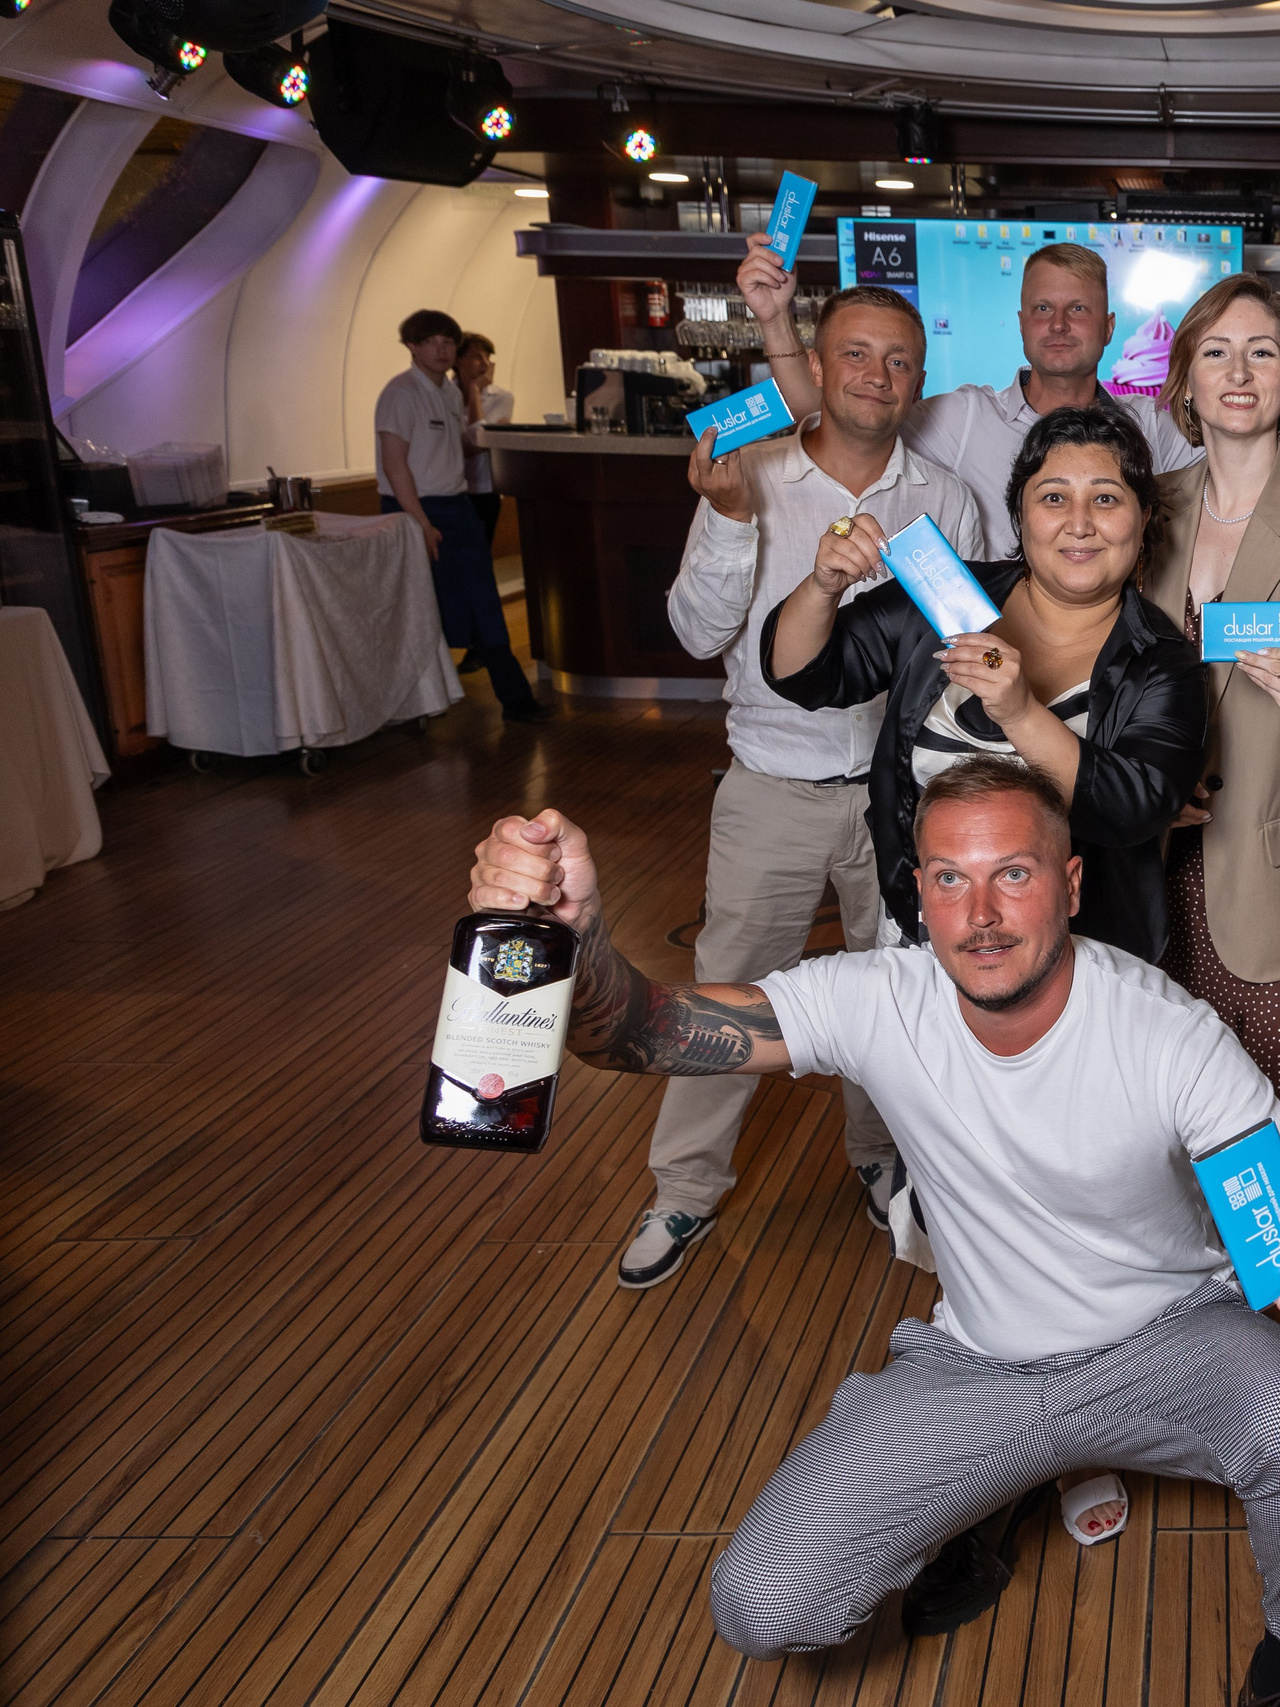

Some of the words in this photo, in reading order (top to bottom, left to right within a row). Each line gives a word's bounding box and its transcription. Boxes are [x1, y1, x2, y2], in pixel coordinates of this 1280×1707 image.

[781, 191, 800, 230] duslar
[863, 231, 907, 242] Hisense
[871, 246, 902, 267] A6
[912, 548, 949, 592] dusla
[1223, 612, 1274, 635] duslar
[478, 1025, 523, 1036] FINEST
[446, 1034, 483, 1043] BLENDED
[486, 1037, 518, 1046] SCOTCH
[520, 1041, 551, 1049] WHISKY
[1257, 1161, 1270, 1185] МЕБЕЛИ
[1265, 1184, 1276, 1198] ДЛЯ
